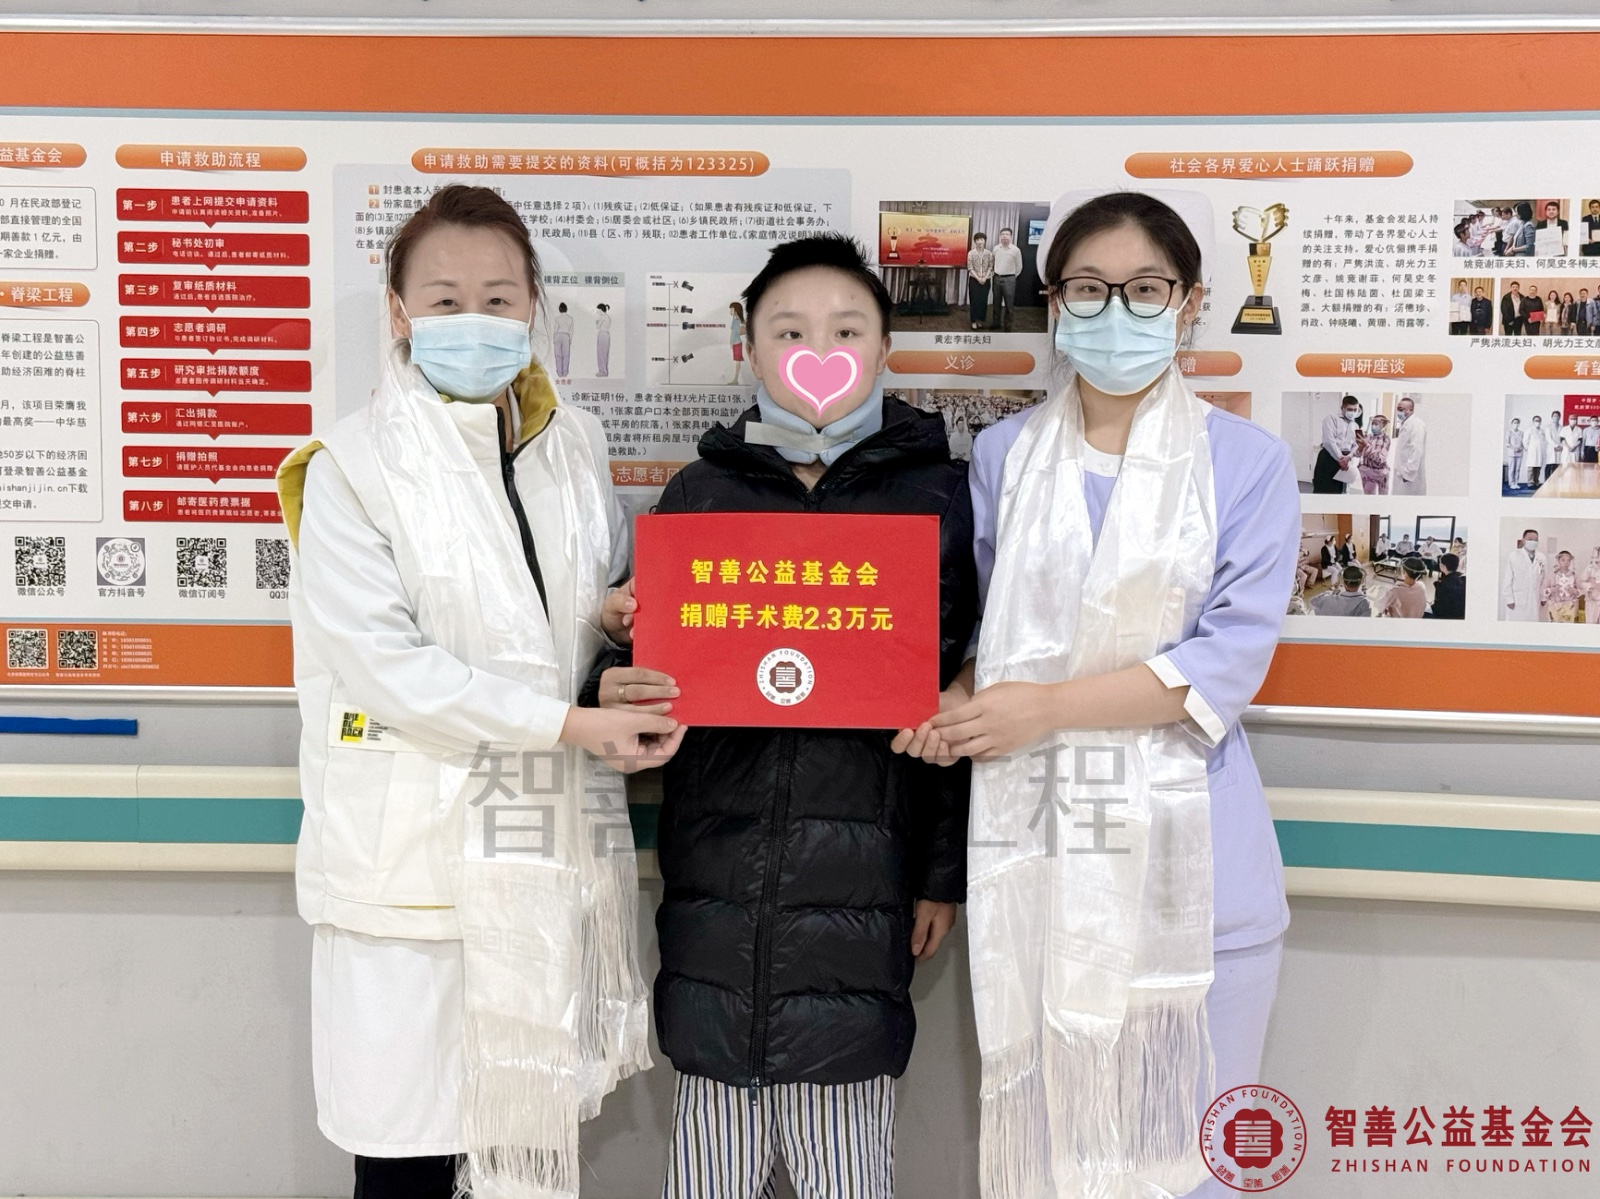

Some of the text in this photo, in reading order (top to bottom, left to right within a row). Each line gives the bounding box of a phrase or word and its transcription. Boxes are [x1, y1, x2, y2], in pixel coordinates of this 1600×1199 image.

[160, 151, 262, 168] 申请救助流程
[424, 152, 755, 172] 申请救助需要提交的资料(可概括为123325)
[1169, 157, 1375, 173] 社会各界爱心人士踊跃捐赠
[122, 199, 158, 211] 第一步
[171, 196, 278, 207] 患者上网提交申请资料
[123, 241, 158, 253] 第二步
[172, 238, 225, 249] 秘书处初审
[124, 284, 159, 296] 第三步
[172, 281, 237, 292] 复审纸质材料
[125, 326, 160, 338] 第四步
[173, 323, 227, 333] 志愿者调研
[1, 333, 85, 344] 脊梁工程是智善公
[934, 334, 991, 345] 黄宏李莉夫妇
[1, 350, 86, 361] 年创建的公益慈善
[943, 355, 976, 371] 义诊
[1340, 358, 1406, 375] 调研座谈
[1, 366, 87, 377] 助经济困难的脊柱
[126, 368, 161, 380] 第五步
[174, 365, 260, 377] 研究审批捐款额度
[127, 411, 162, 423] 第六步
[175, 408, 218, 419] 汇出捐款
[128, 456, 163, 468] 第七步
[176, 451, 218, 462] 捐赠拍照
[129, 501, 164, 512] 第八步
[177, 497, 251, 508] 邮寄医药费票据
[691, 558, 879, 586] 智善公益基金会
[17, 587, 65, 598] 微信公众号
[98, 588, 146, 598] 官方抖音号
[178, 589, 226, 599] 微信订阅号
[680, 602, 894, 631] 捐赠手术费2.3万元
[759, 650, 813, 685] ZHISHAN FOUNDATION
